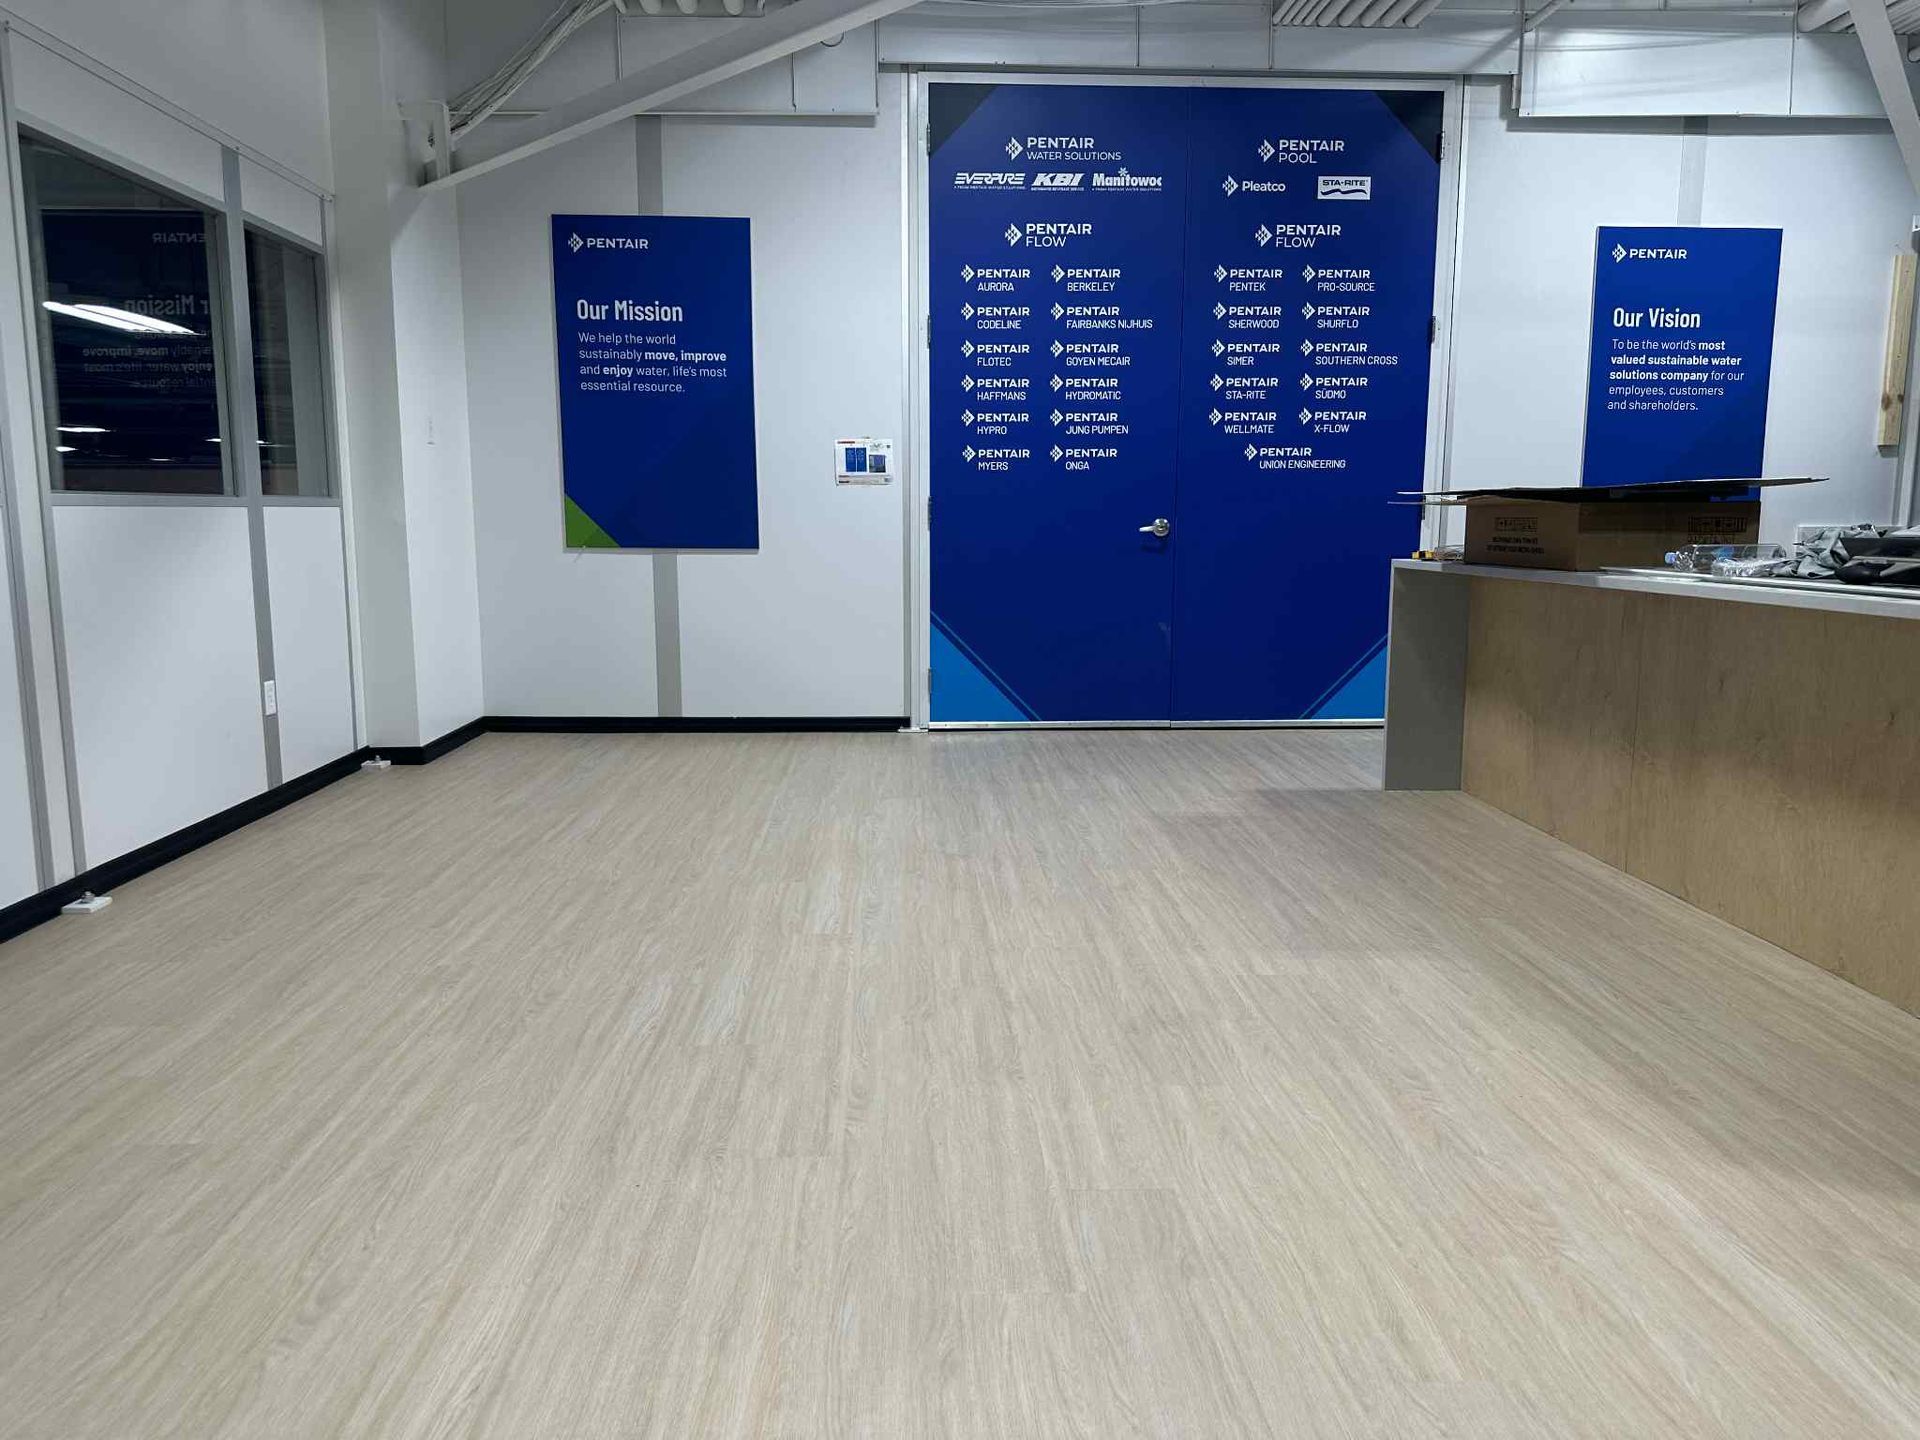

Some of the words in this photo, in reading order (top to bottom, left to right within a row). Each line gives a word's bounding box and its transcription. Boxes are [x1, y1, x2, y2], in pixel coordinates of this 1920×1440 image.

[1027, 137, 1094, 148] PENTAIR
[1279, 140, 1344, 151] PENTAIR
[1027, 152, 1062, 160] WATER
[1065, 152, 1121, 160] SOLUTIONS
[1279, 153, 1317, 163] POOL
[954, 173, 1026, 185] EVERPURE
[1092, 173, 1162, 186] Manitowoc
[1242, 181, 1286, 191] Pleatco
[1026, 224, 1092, 234] PENTAIR
[1276, 225, 1341, 235] PENTAIR
[587, 238, 649, 249] PENTAIR
[1026, 237, 1066, 247] FLOW
[1276, 237, 1315, 248] FLOW
[1629, 249, 1687, 259] PENTAIR
[977, 269, 1030, 278] PENTAIR
[1068, 269, 1120, 278] PENTAIR
[1230, 270, 1282, 278] PENTAIR
[1318, 270, 1370, 278] PENTAIR
[977, 282, 1014, 291] AURORA
[1068, 282, 1115, 291] BERKELEY
[1230, 283, 1265, 291] PENTEK
[1318, 283, 1375, 291] PRO-SOURCE
[577, 300, 608, 320] Our
[615, 301, 683, 321] Mission
[977, 307, 1030, 316] PENTAIR
[1067, 307, 1119, 316] PENTAIR
[1229, 307, 1281, 315] PENTAIR
[1318, 307, 1369, 315] PENTAIR
[1614, 308, 1643, 327] Our
[1649, 308, 1701, 328] Vision
[977, 320, 1021, 329] CODELINE
[1067, 320, 1116, 328] FAIRBANKS
[1118, 320, 1152, 328] NIJHUIS
[1228, 320, 1279, 329] SHERWOOD
[1317, 320, 1358, 329] SHURFLO
[578, 332, 596, 343] We
[599, 333, 622, 346] help
[624, 334, 643, 344] the
[646, 334, 676, 344] world
[977, 345, 1029, 353] PENTAIR
[1067, 344, 1118, 353] PENTAIR
[1227, 344, 1280, 352] PENTAIR
[1316, 344, 1367, 352] PENTAIR
[1612, 339, 1624, 349] To
[1627, 339, 1639, 349] be
[1642, 340, 1658, 349] the
[1661, 340, 1696, 350] world's
[1699, 341, 1725, 350] most
[579, 349, 642, 362] sustainably
[645, 351, 678, 361] move,
[681, 350, 726, 363] improve
[1315, 356, 1365, 365] SOUTHERN
[1367, 356, 1398, 365] CROSS
[1611, 355, 1645, 365] valued
[1648, 355, 1708, 365] sustainable
[1711, 356, 1741, 365] water
[977, 357, 1011, 366] FLOTEC
[1066, 357, 1095, 366] GOYEN
[1097, 357, 1130, 366] MECAIR
[1227, 357, 1254, 365] SIMER
[580, 365, 600, 375] and
[603, 365, 633, 377] enjoy
[636, 367, 669, 377] water,
[673, 365, 697, 377] life's
[699, 367, 727, 377] most
[1609, 370, 1658, 380] solutions
[1661, 371, 1708, 382] company
[1711, 371, 1725, 380] for
[1727, 372, 1744, 381] our
[581, 380, 630, 391] essential
[634, 382, 685, 392] resource.
[977, 379, 1029, 387] PENTAIR
[1066, 379, 1118, 387] PENTAIR
[1226, 378, 1278, 387] PENTAIR
[1316, 378, 1367, 386] PENTAIR
[977, 392, 1026, 400] HAFFMANS
[1065, 391, 1121, 400] HYDROMATIC
[1609, 386, 1666, 397] employees,
[1669, 387, 1724, 396] customers
[1608, 400, 1626, 410] and
[1629, 400, 1698, 411] shareholders.
[977, 413, 1029, 422] PENTAIR
[1066, 413, 1118, 422] PENTAIR
[1225, 413, 1276, 421] PENTAIR
[1315, 412, 1366, 420] PENTAIR
[977, 426, 1007, 435] HYPRO
[1066, 426, 1089, 434] JUNG
[1092, 426, 1128, 434] PUMPEN
[1224, 425, 1274, 433] WELLMATE
[1314, 424, 1350, 433] X-FLOW
[979, 449, 1030, 458] PENTAIR
[1066, 449, 1117, 457] PENTAIR
[1260, 448, 1311, 456] PENTAIR
[978, 462, 1008, 471] MYERS
[1065, 461, 1089, 470] ONGA
[1260, 460, 1286, 469] UNION
[1288, 460, 1345, 469] ENGINEERING
